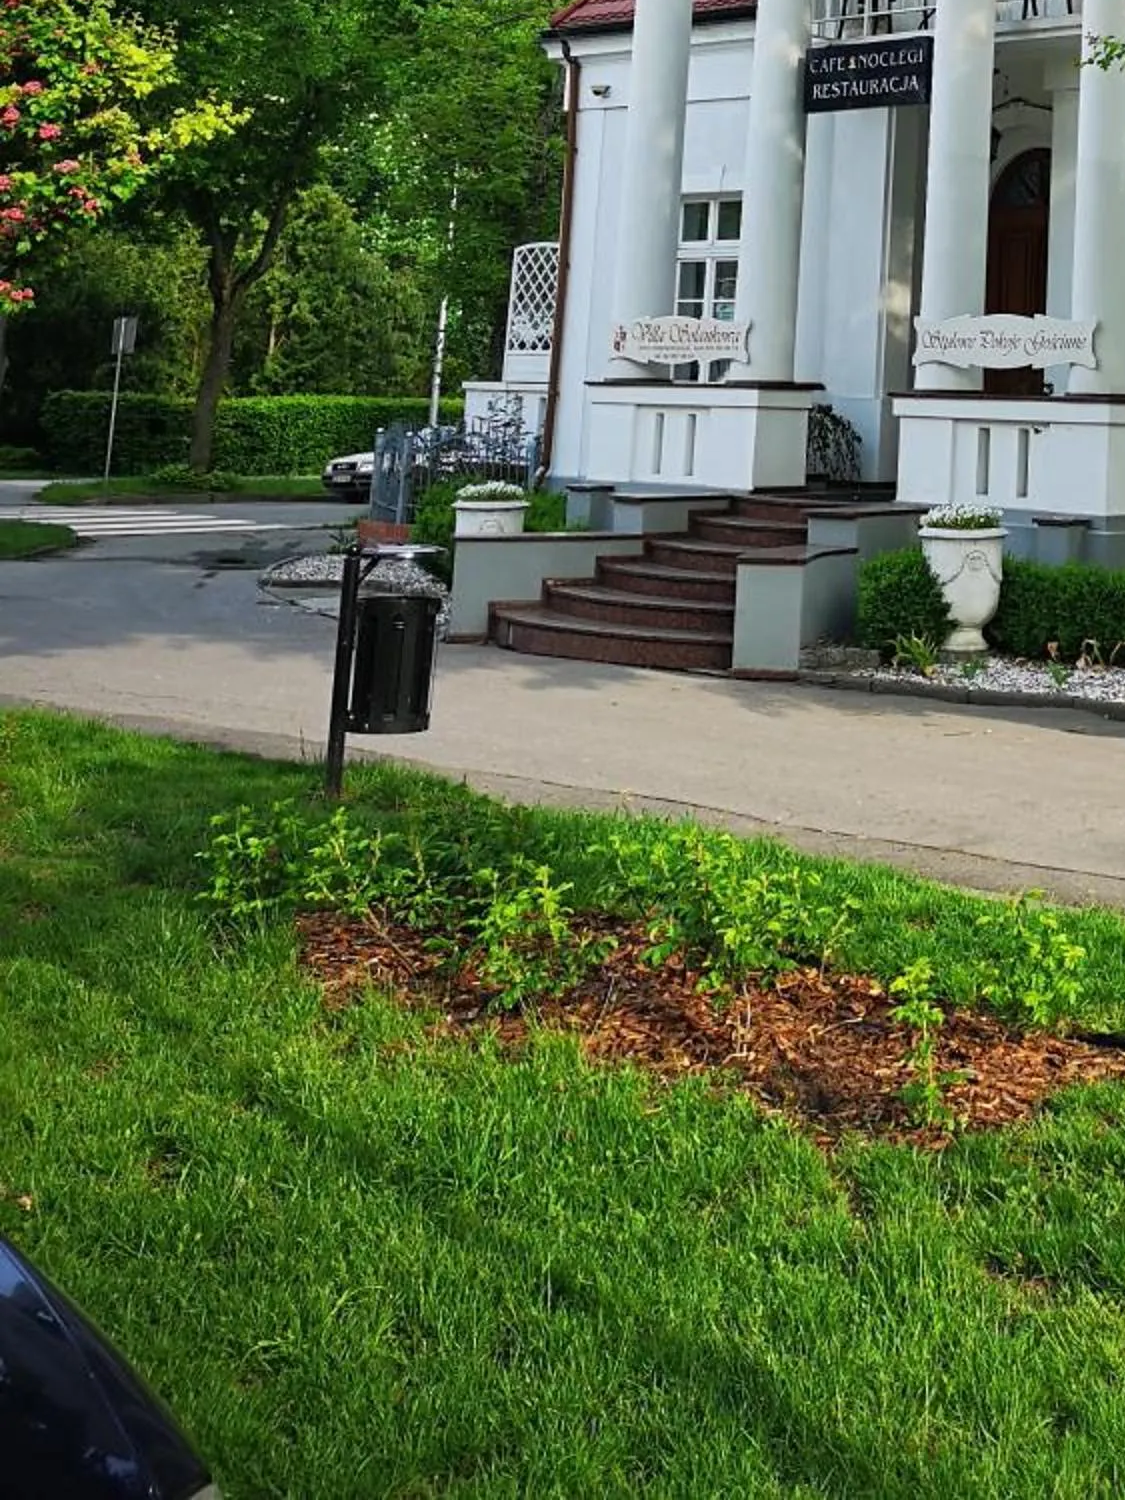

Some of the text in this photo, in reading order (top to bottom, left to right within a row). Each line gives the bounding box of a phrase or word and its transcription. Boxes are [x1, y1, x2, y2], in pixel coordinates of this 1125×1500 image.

[809, 48, 924, 74] CAFE NOCLEGI
[812, 74, 919, 100] RESTAURACJA
